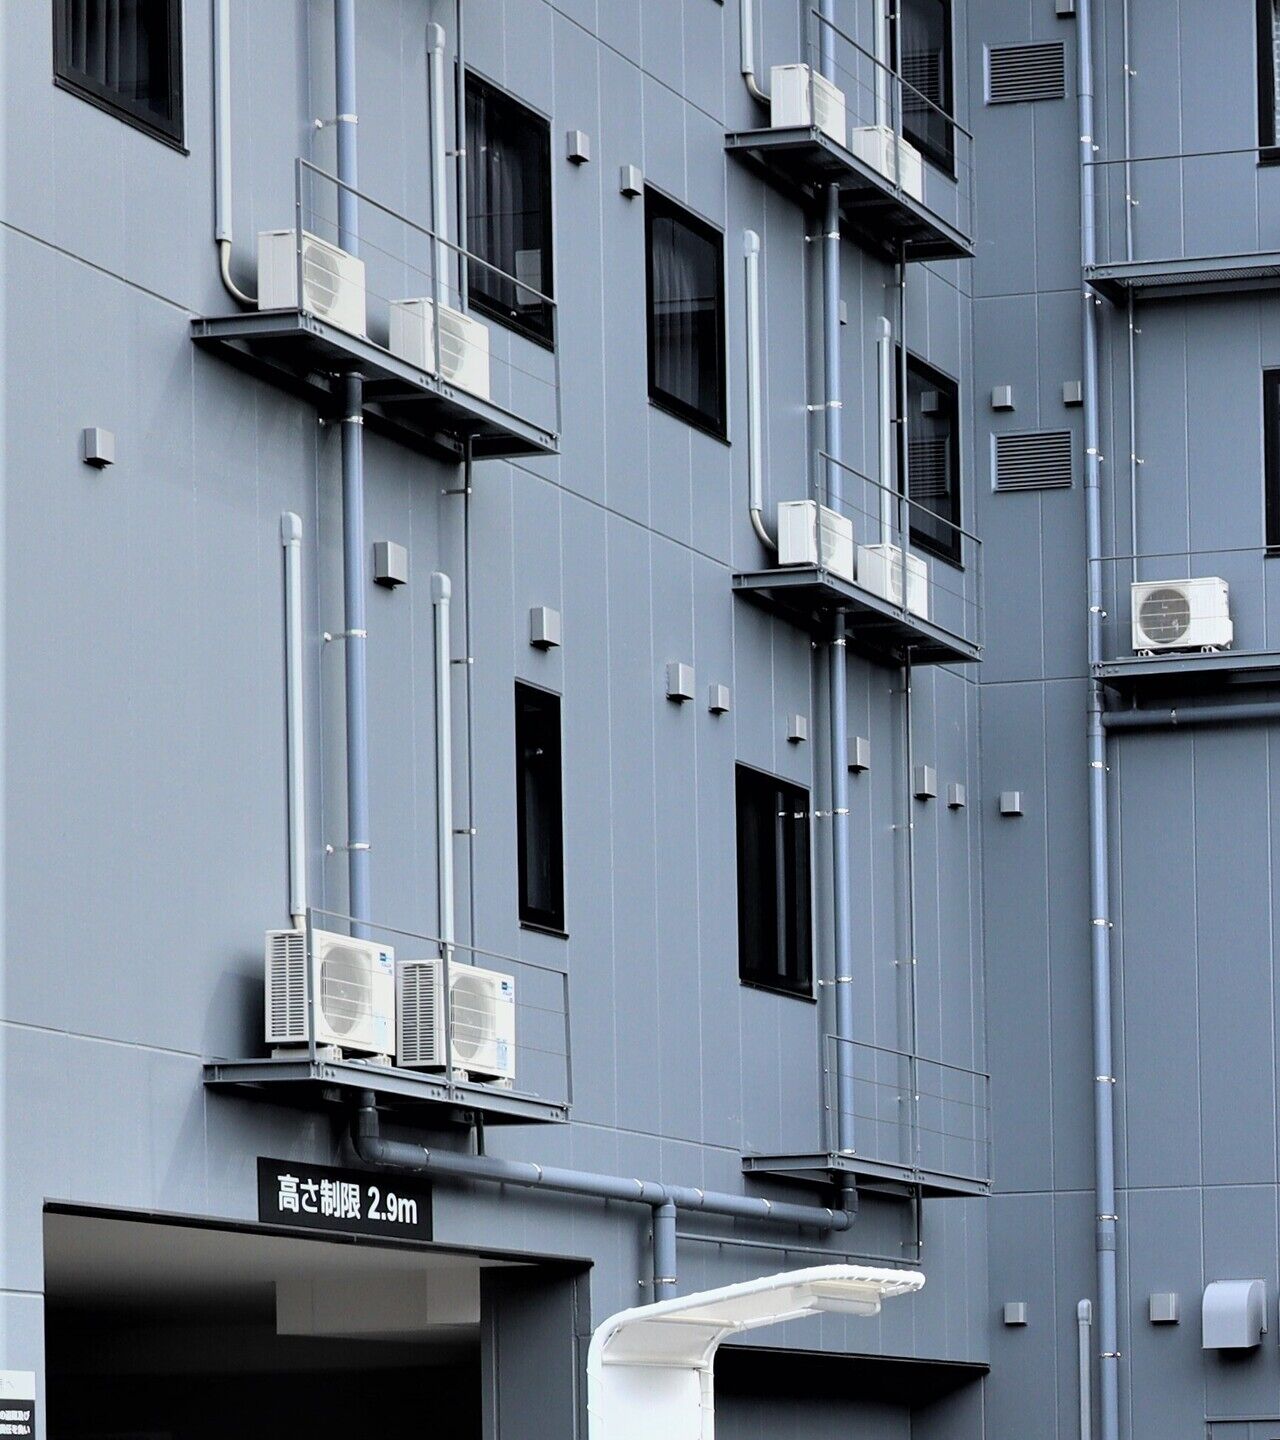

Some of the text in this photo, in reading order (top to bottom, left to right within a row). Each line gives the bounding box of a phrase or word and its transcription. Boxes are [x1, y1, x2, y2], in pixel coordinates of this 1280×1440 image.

[277, 1174, 418, 1225] 高さ制限 2.9m
